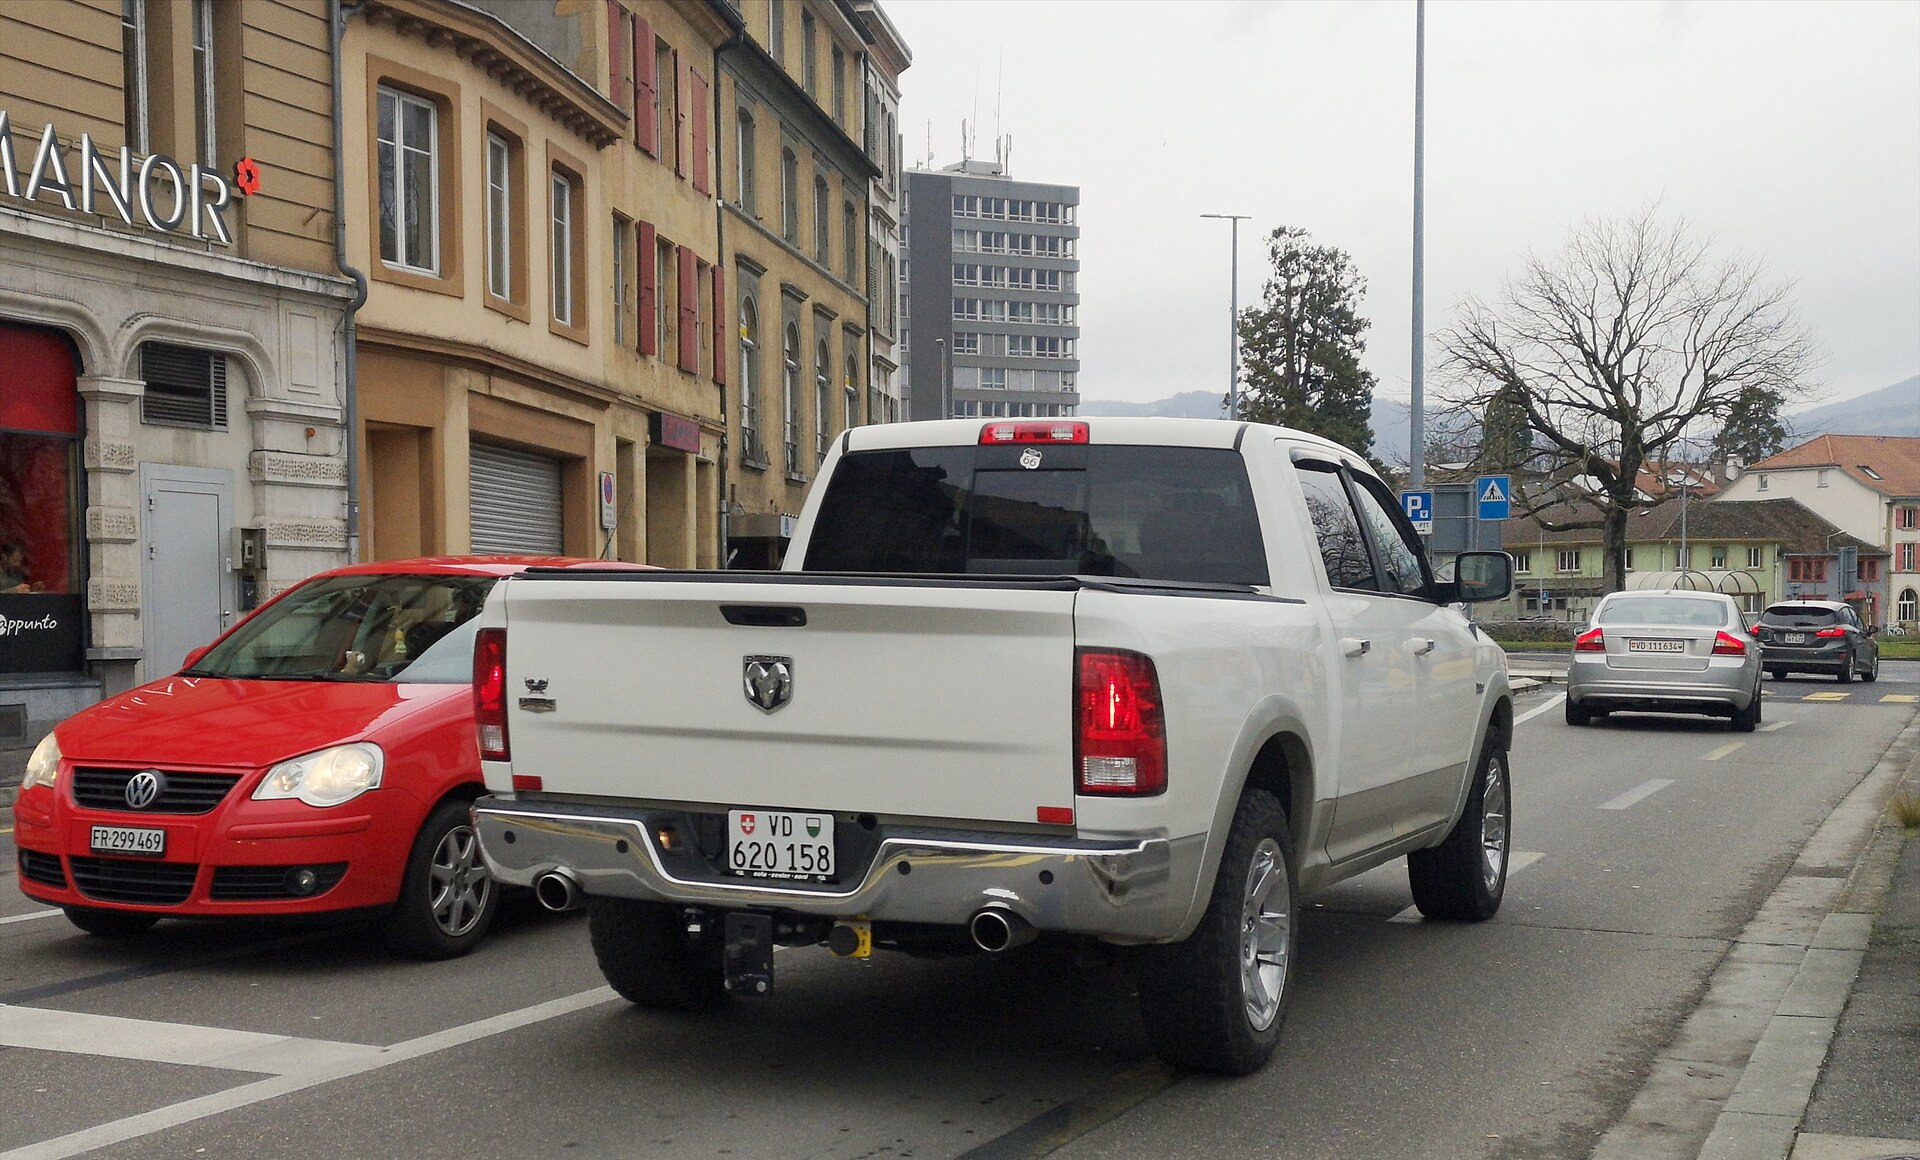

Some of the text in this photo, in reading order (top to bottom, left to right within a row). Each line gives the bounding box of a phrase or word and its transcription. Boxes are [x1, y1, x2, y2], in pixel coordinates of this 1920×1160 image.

[1023, 456, 1036, 467] 66
[1407, 495, 1422, 517] P
[768, 815, 793, 836] VD
[733, 840, 830, 872] 620 158
